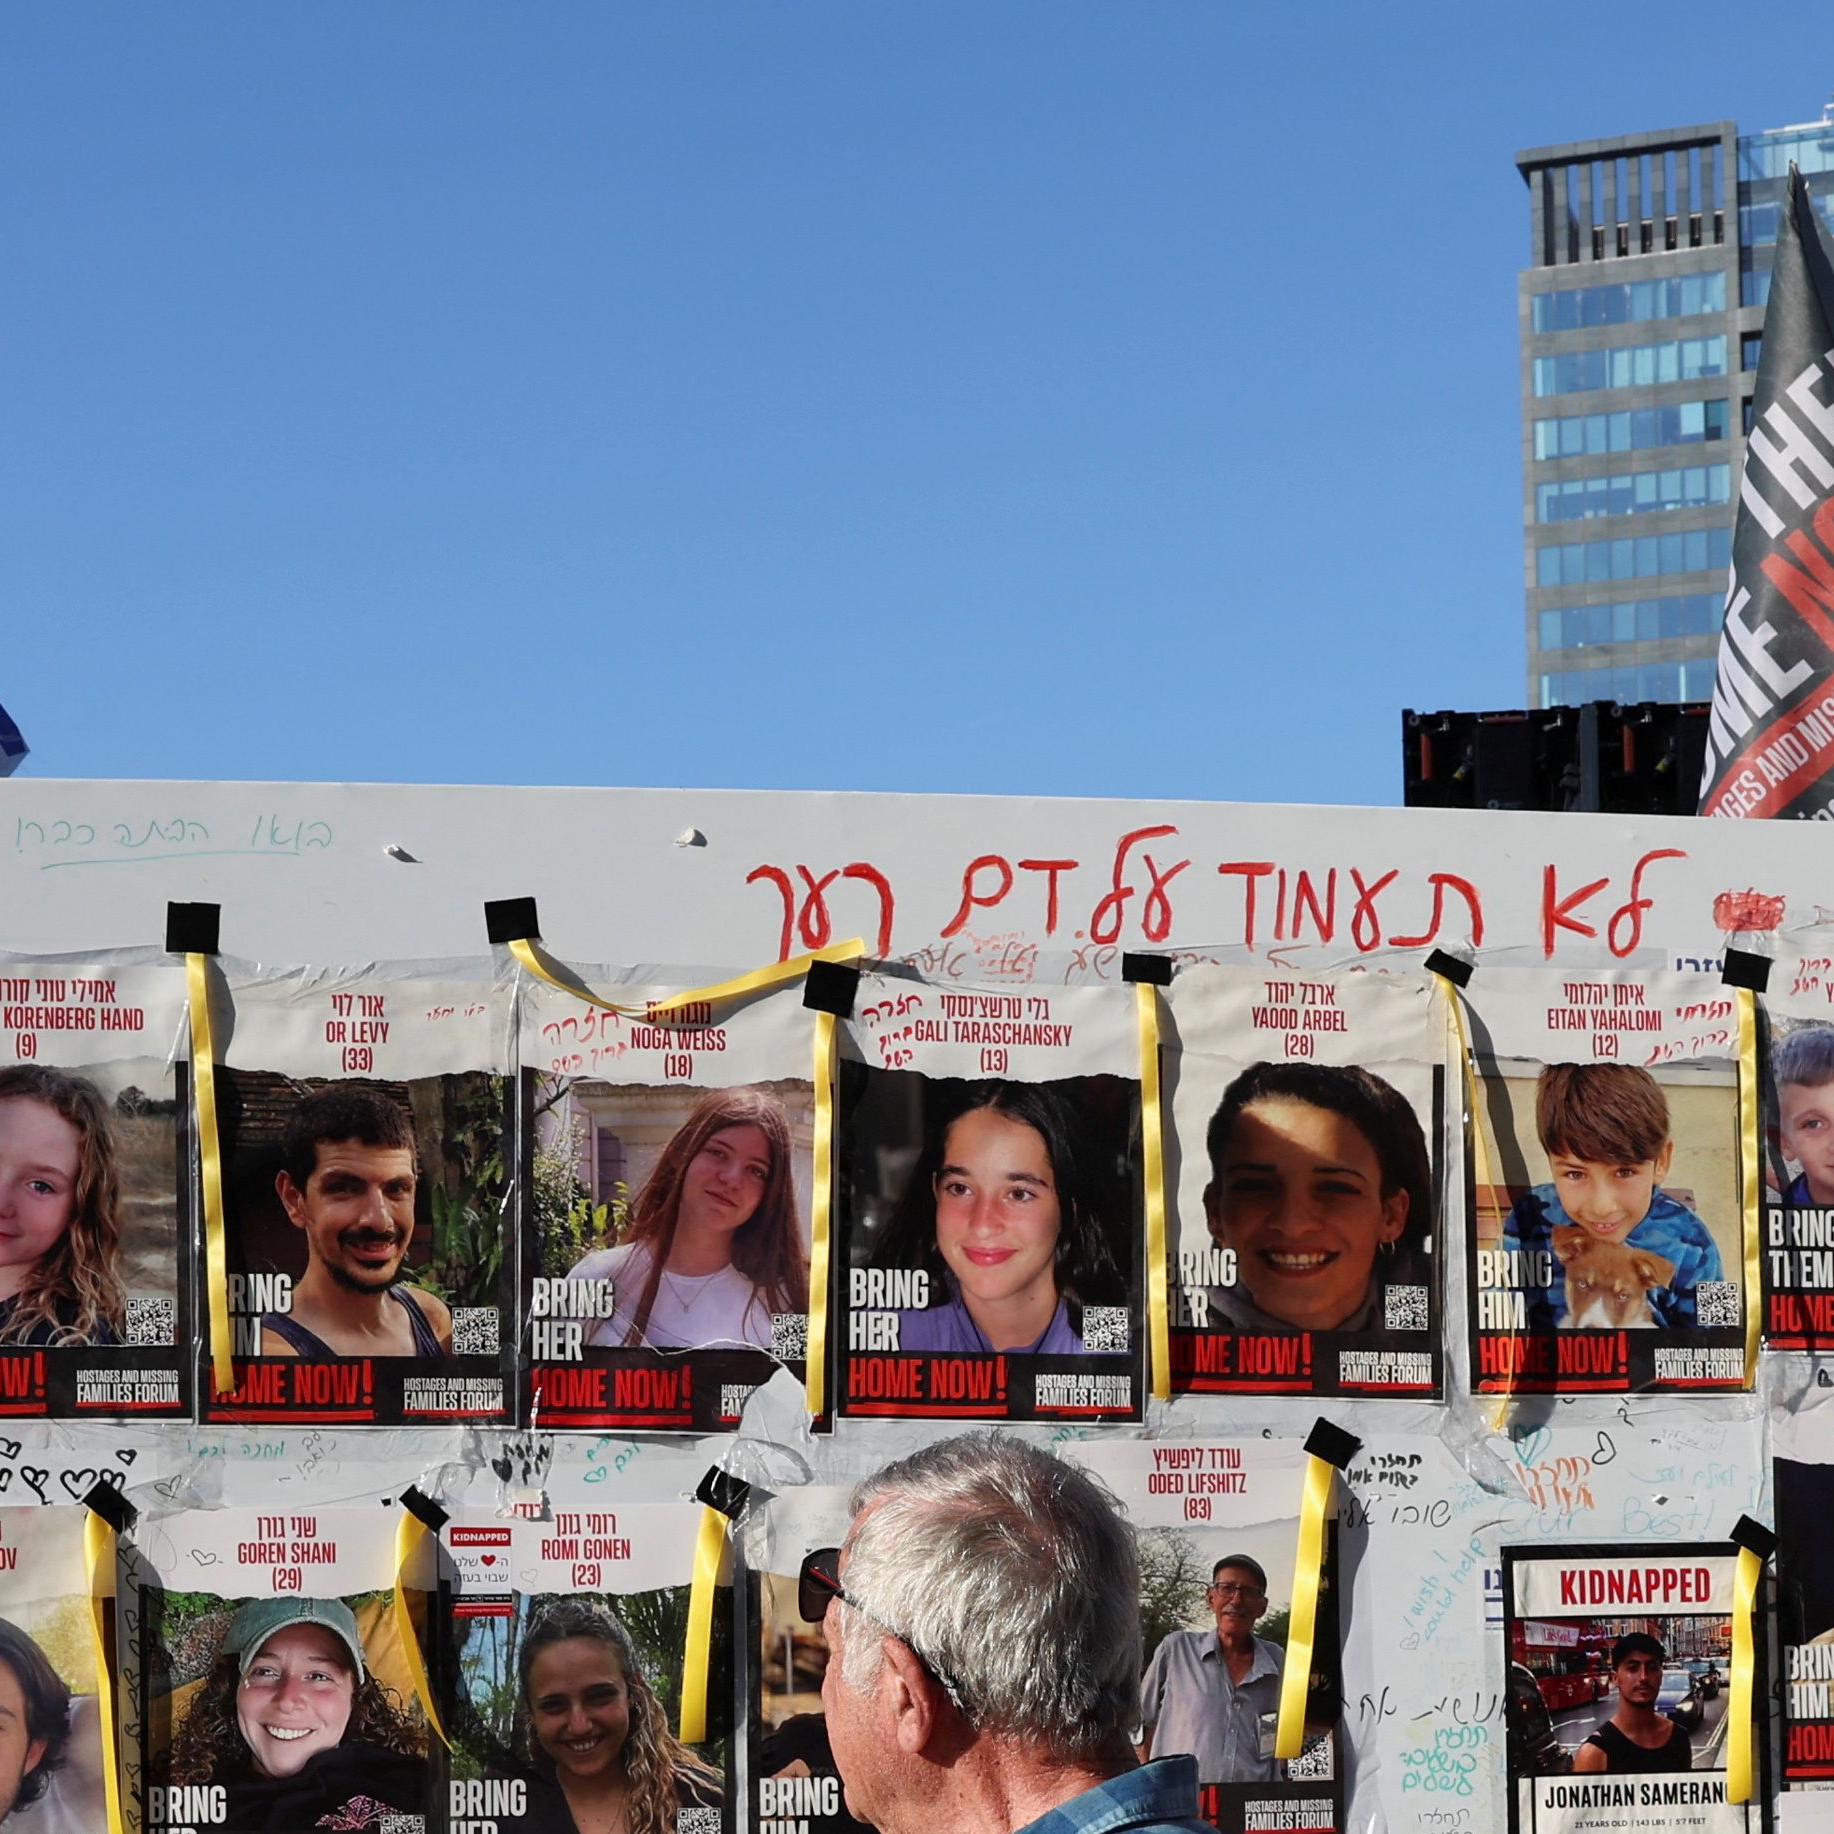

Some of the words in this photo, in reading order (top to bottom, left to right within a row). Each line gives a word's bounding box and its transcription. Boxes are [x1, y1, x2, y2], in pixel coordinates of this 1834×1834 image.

[1755, 732, 1808, 784] AND
[940, 855, 1079, 939] דם
[1088, 823, 1192, 947] על
[1217, 859, 1484, 955] תעמוד
[1541, 847, 1690, 960] לא
[5, 1007, 94, 1029] KORENBERG
[102, 1009, 142, 1029] HAND
[1253, 1008, 1297, 1029] YAOOD
[1304, 1010, 1346, 1031] ARBEL
[1549, 1009, 1586, 1028] EITAN
[1592, 1010, 1661, 1030] YAHALOMI
[327, 1022, 345, 1042] OR
[353, 1022, 388, 1043] LEVY
[632, 1025, 671, 1048] NOGA
[678, 1029, 725, 1050] WEISS
[916, 1020, 947, 1041] GALI
[954, 1022, 1071, 1045] TARASCHANSKY
[1149, 1474, 1182, 1493] ODED
[1189, 1473, 1245, 1493] LIFSHITZ
[453, 1533, 509, 1542] KIDNAPPED
[543, 1540, 578, 1559] ROMI
[584, 1540, 630, 1559] GONEN
[239, 1543, 285, 1563] GOREN
[292, 1543, 335, 1563] SHANI
[1561, 1568, 1711, 1605] KIDNAPPED
[1545, 1785, 1635, 1808] JONATHAN
[1641, 1782, 1728, 1805] SAMERAN
[1688, 1817, 1705, 1825] FEET
